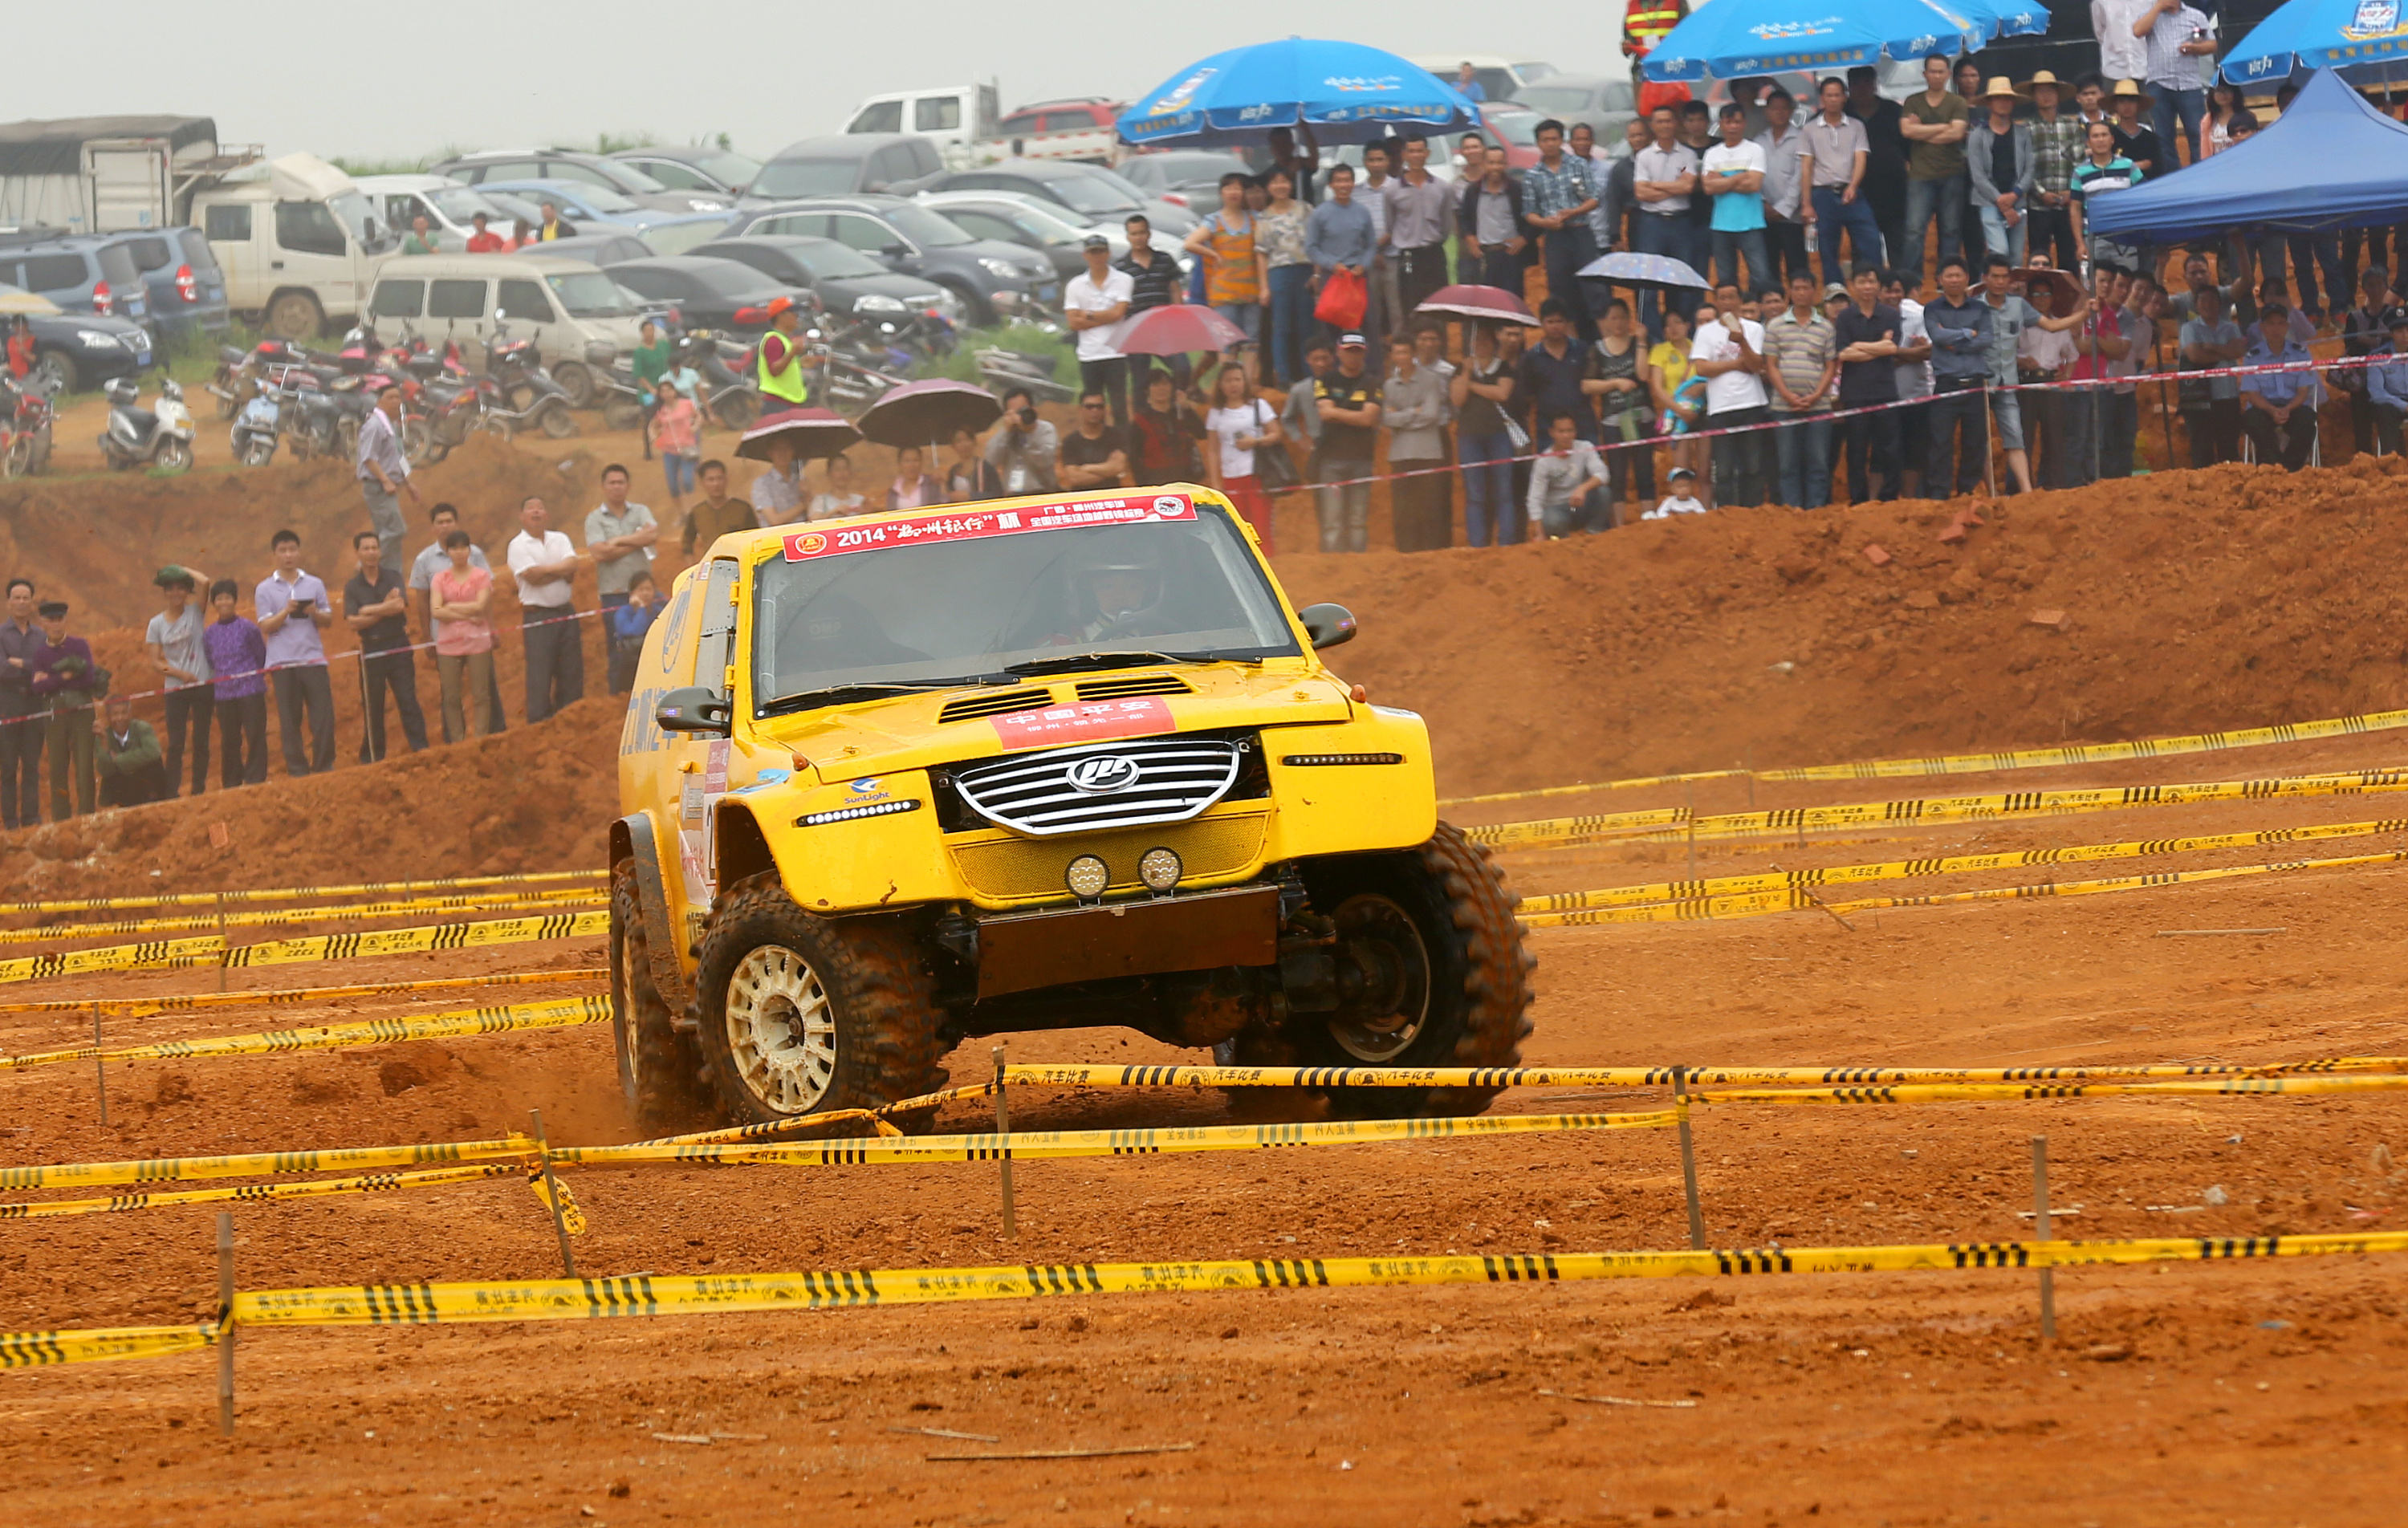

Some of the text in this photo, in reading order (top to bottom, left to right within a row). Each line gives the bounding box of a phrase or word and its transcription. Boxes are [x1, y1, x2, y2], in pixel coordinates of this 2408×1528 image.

[1006, 701, 1153, 725] 中国平安
[844, 792, 890, 804] SunLight
[1848, 866, 1882, 877] 汽车比赛
[1042, 1069, 1091, 1084] 汽车比赛
[1213, 1068, 1263, 1082] 汽车比赛
